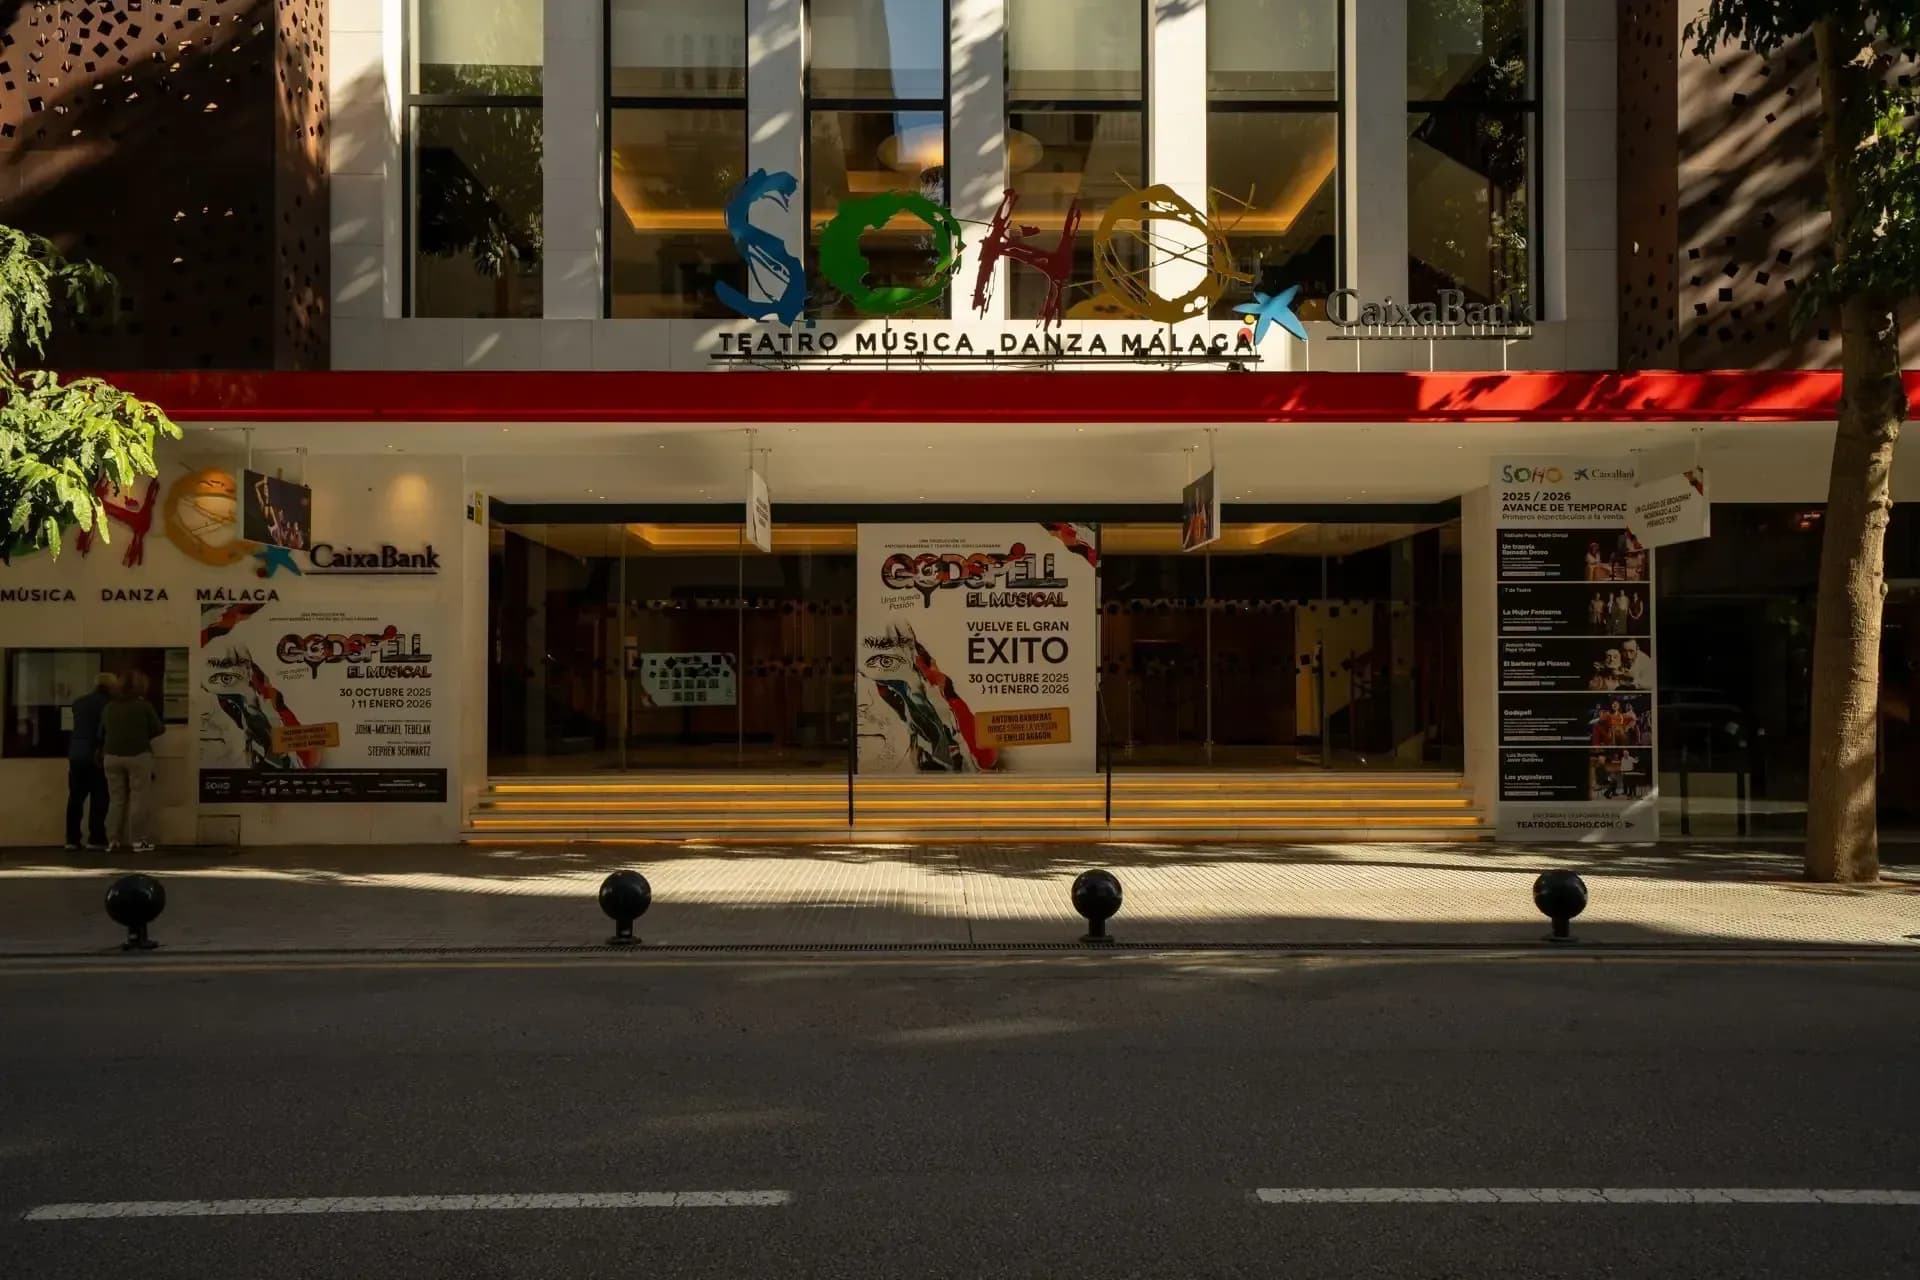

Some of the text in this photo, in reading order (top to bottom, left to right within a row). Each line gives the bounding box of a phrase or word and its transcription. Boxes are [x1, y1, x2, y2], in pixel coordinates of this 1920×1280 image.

[714, 168, 1255, 331] SOHO
[1326, 288, 1536, 327] CaixaBank
[719, 328, 1253, 353] TEATRO MÚSICA DANZA MÁLAGA
[1502, 465, 1563, 484] SOHO
[1502, 492, 1530, 501] 2025
[1543, 492, 1571, 501] 2026
[1502, 503, 1628, 512] AVANCE DE TEMPORAD
[1537, 513, 1586, 522] espectáculos
[309, 545, 440, 569] CaixaBank
[0, 586, 280, 602] MÚSICA DANZA MÁLAGA
[966, 592, 1069, 608] EL MUSICAL
[966, 622, 1069, 631] VUELVE EL GRAN
[967, 633, 1069, 665] ÉXITO
[347, 665, 432, 679] EL MUSICAL
[968, 673, 1069, 683] 30 OCTUBRE 2025
[340, 688, 432, 697] 30 OCTUBRE 2025
[988, 685, 1070, 694] 11 ENERO 2026
[358, 699, 432, 708] 11 ENERO 2026
[355, 723, 402, 735] JOHN-MICHAEL
[368, 745, 431, 756] STEPHEN SCHWARTZ
[1516, 820, 1614, 829] TEATRODELSOHO.COM
